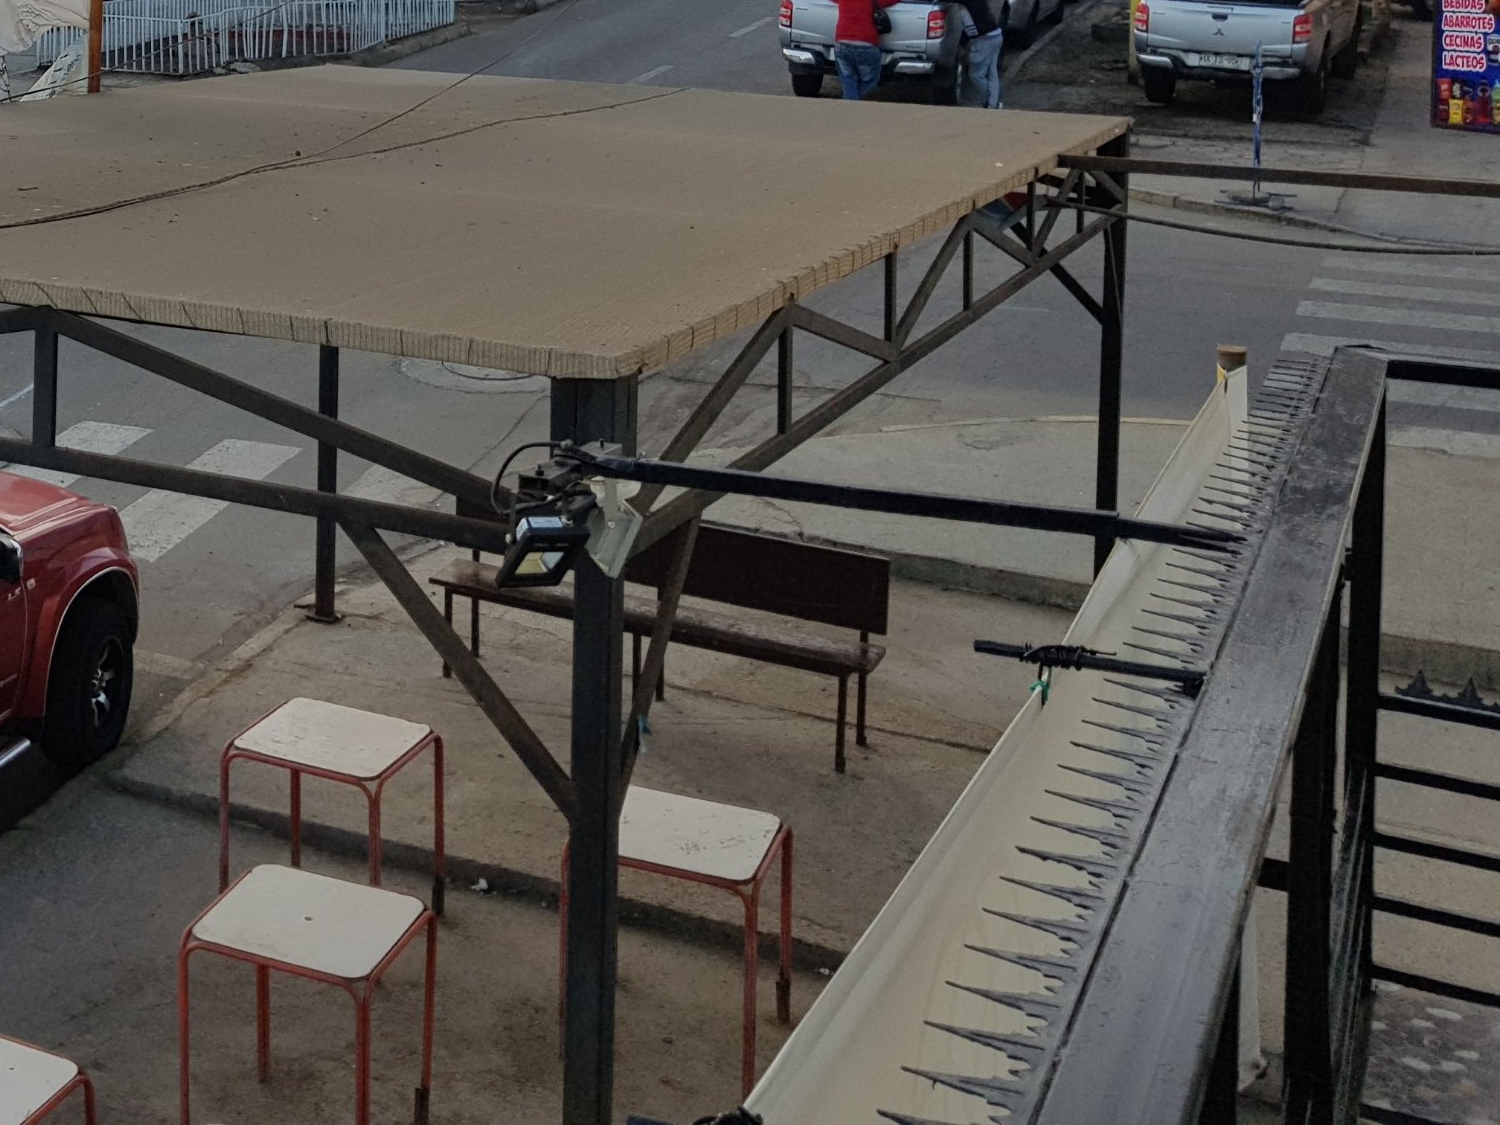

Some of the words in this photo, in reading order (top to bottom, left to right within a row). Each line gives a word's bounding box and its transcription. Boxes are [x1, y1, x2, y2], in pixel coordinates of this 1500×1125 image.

[1443, 14, 1494, 31] ABARROTES
[1443, 35, 1483, 50] CECINAS
[1443, 55, 1485, 70] LACTEOS
